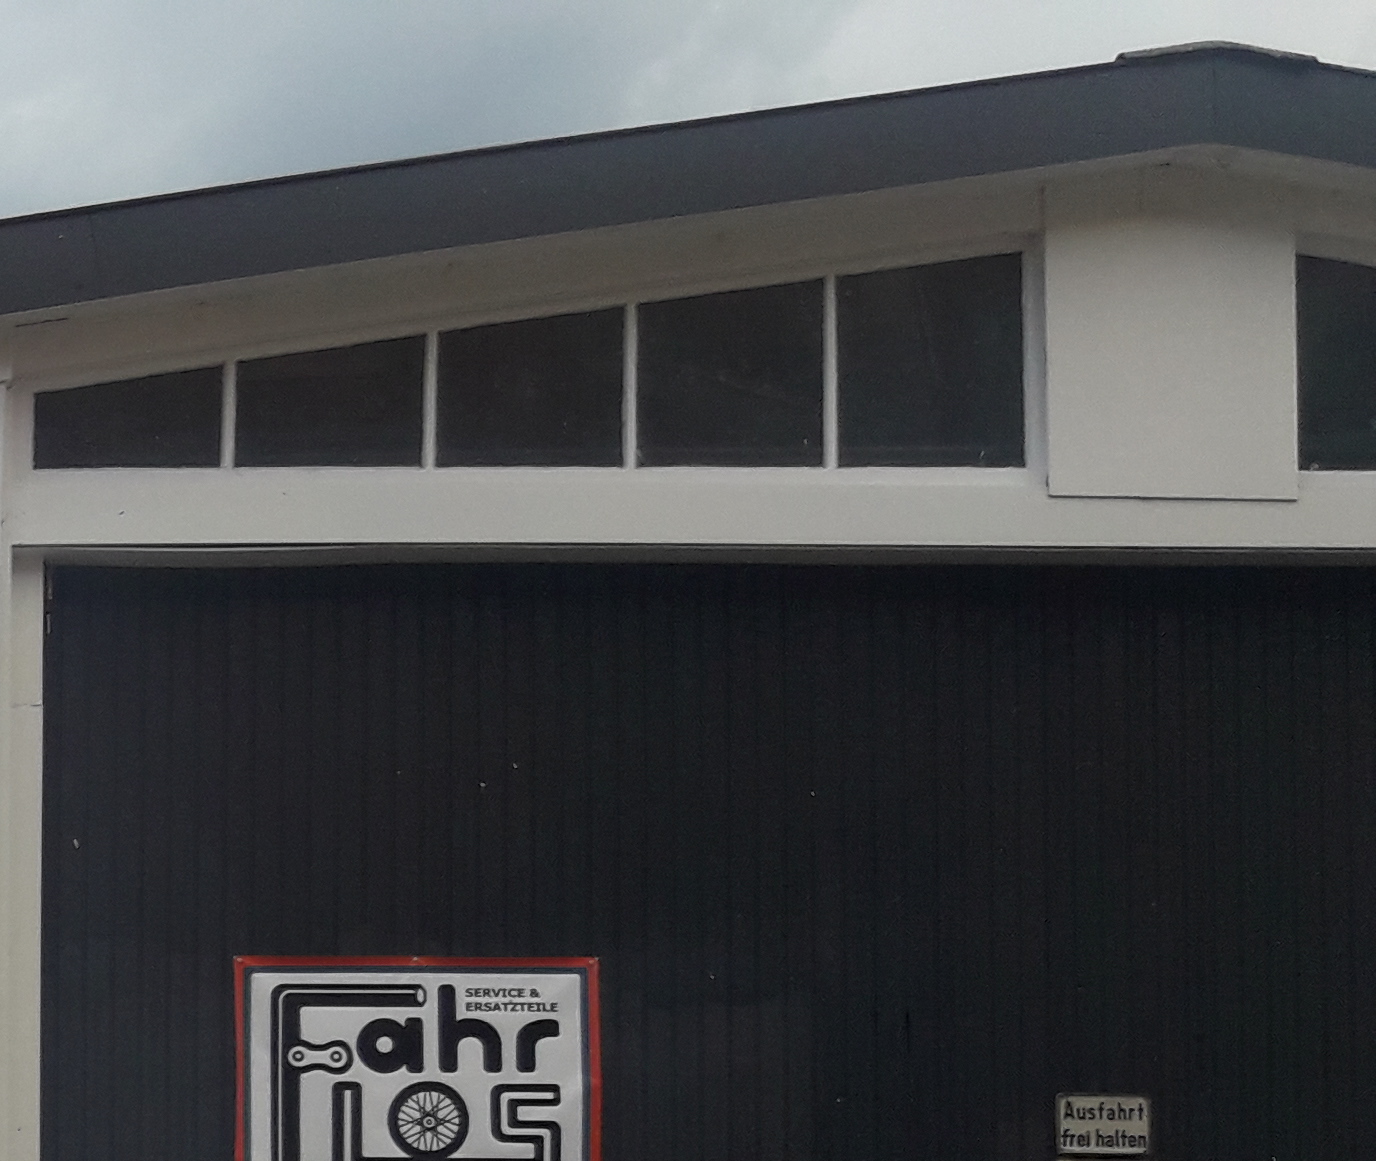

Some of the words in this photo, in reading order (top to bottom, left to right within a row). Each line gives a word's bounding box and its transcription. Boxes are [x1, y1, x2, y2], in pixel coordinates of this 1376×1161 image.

[465, 987, 526, 998] SERVICE
[529, 988, 541, 998] &
[465, 1002, 559, 1013] ERSATZTEILE
[1064, 1101, 1144, 1121] Ausfahrt
[1061, 1129, 1090, 1148] frei
[1096, 1128, 1147, 1148] halten
